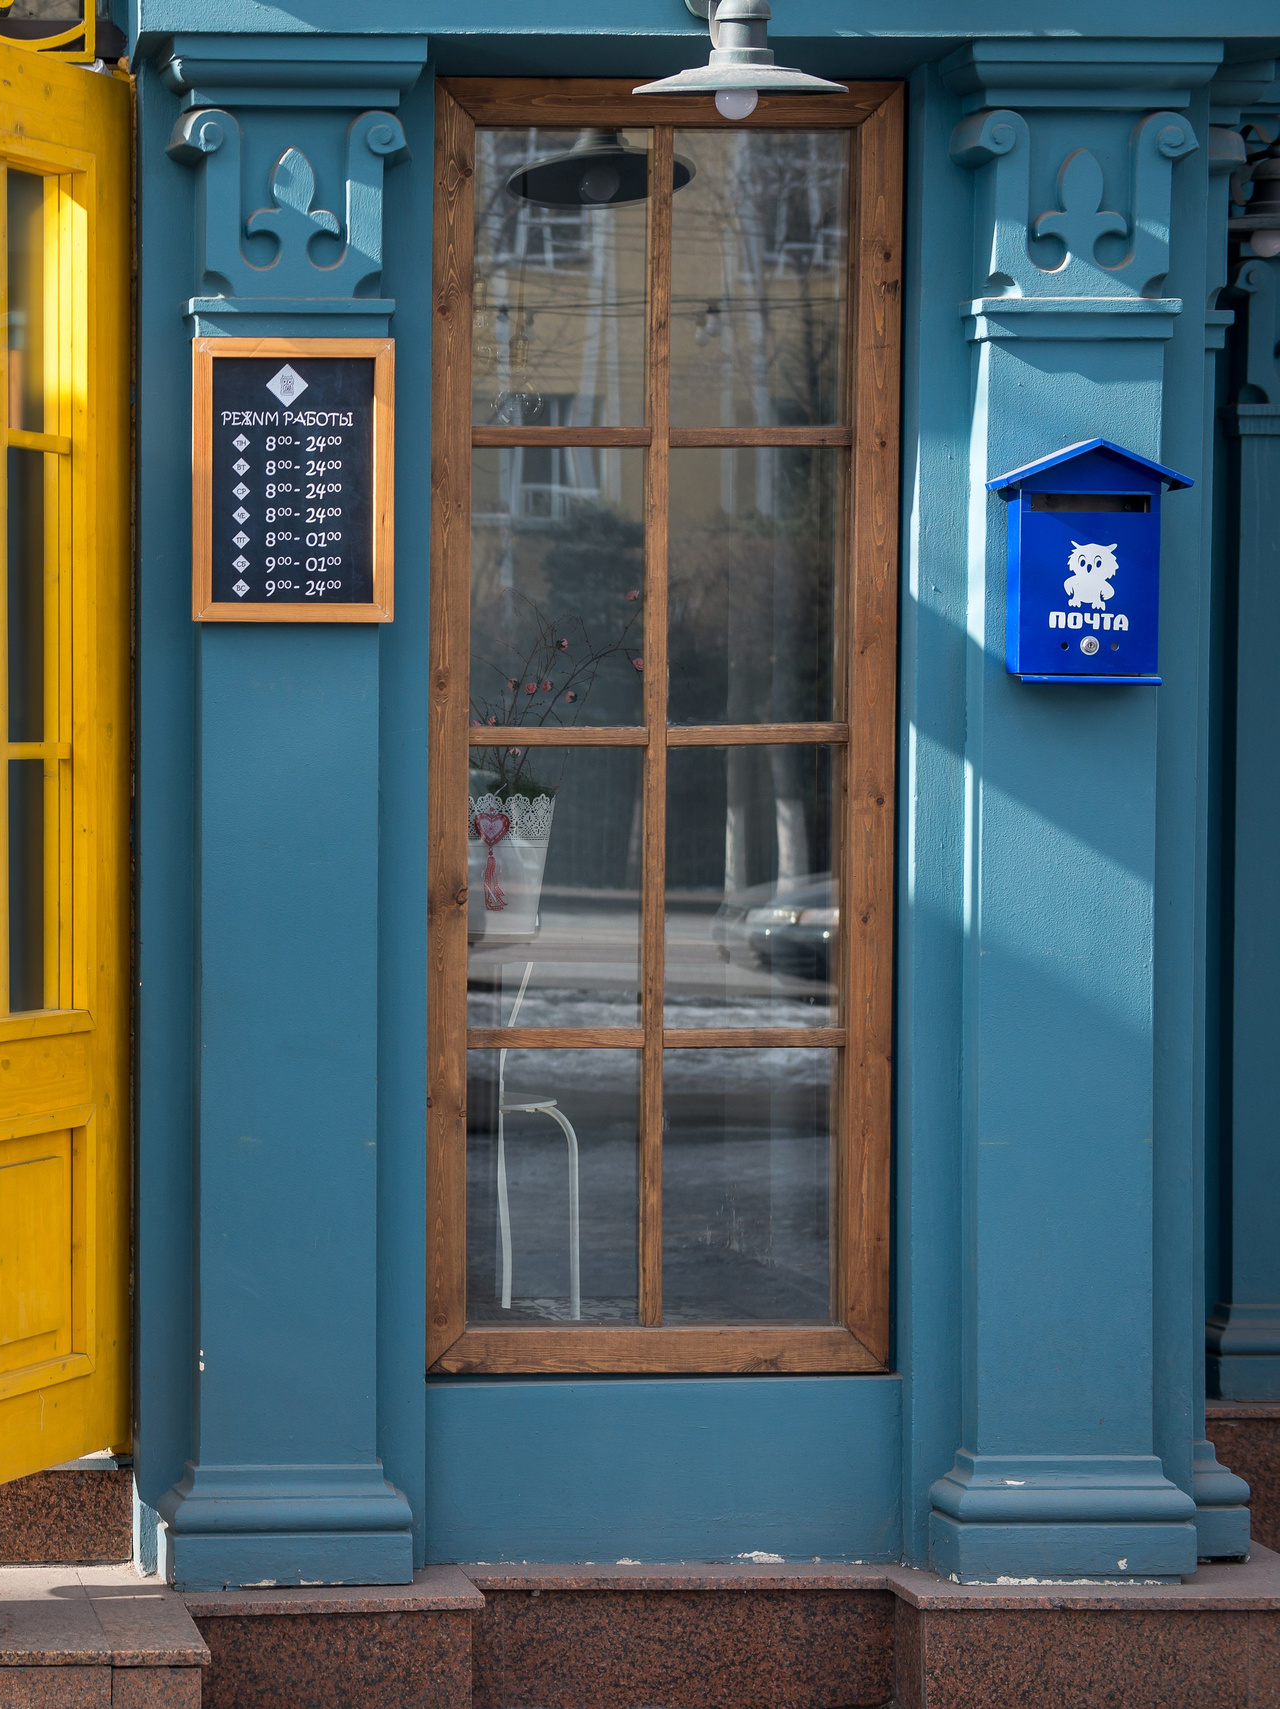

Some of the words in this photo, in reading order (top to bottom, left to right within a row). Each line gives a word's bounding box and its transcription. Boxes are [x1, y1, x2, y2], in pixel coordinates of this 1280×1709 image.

[283, 411, 353, 427] РАБОТЫ
[236, 463, 247, 471] ВТ
[1048, 611, 1129, 632] ПОЧТА
